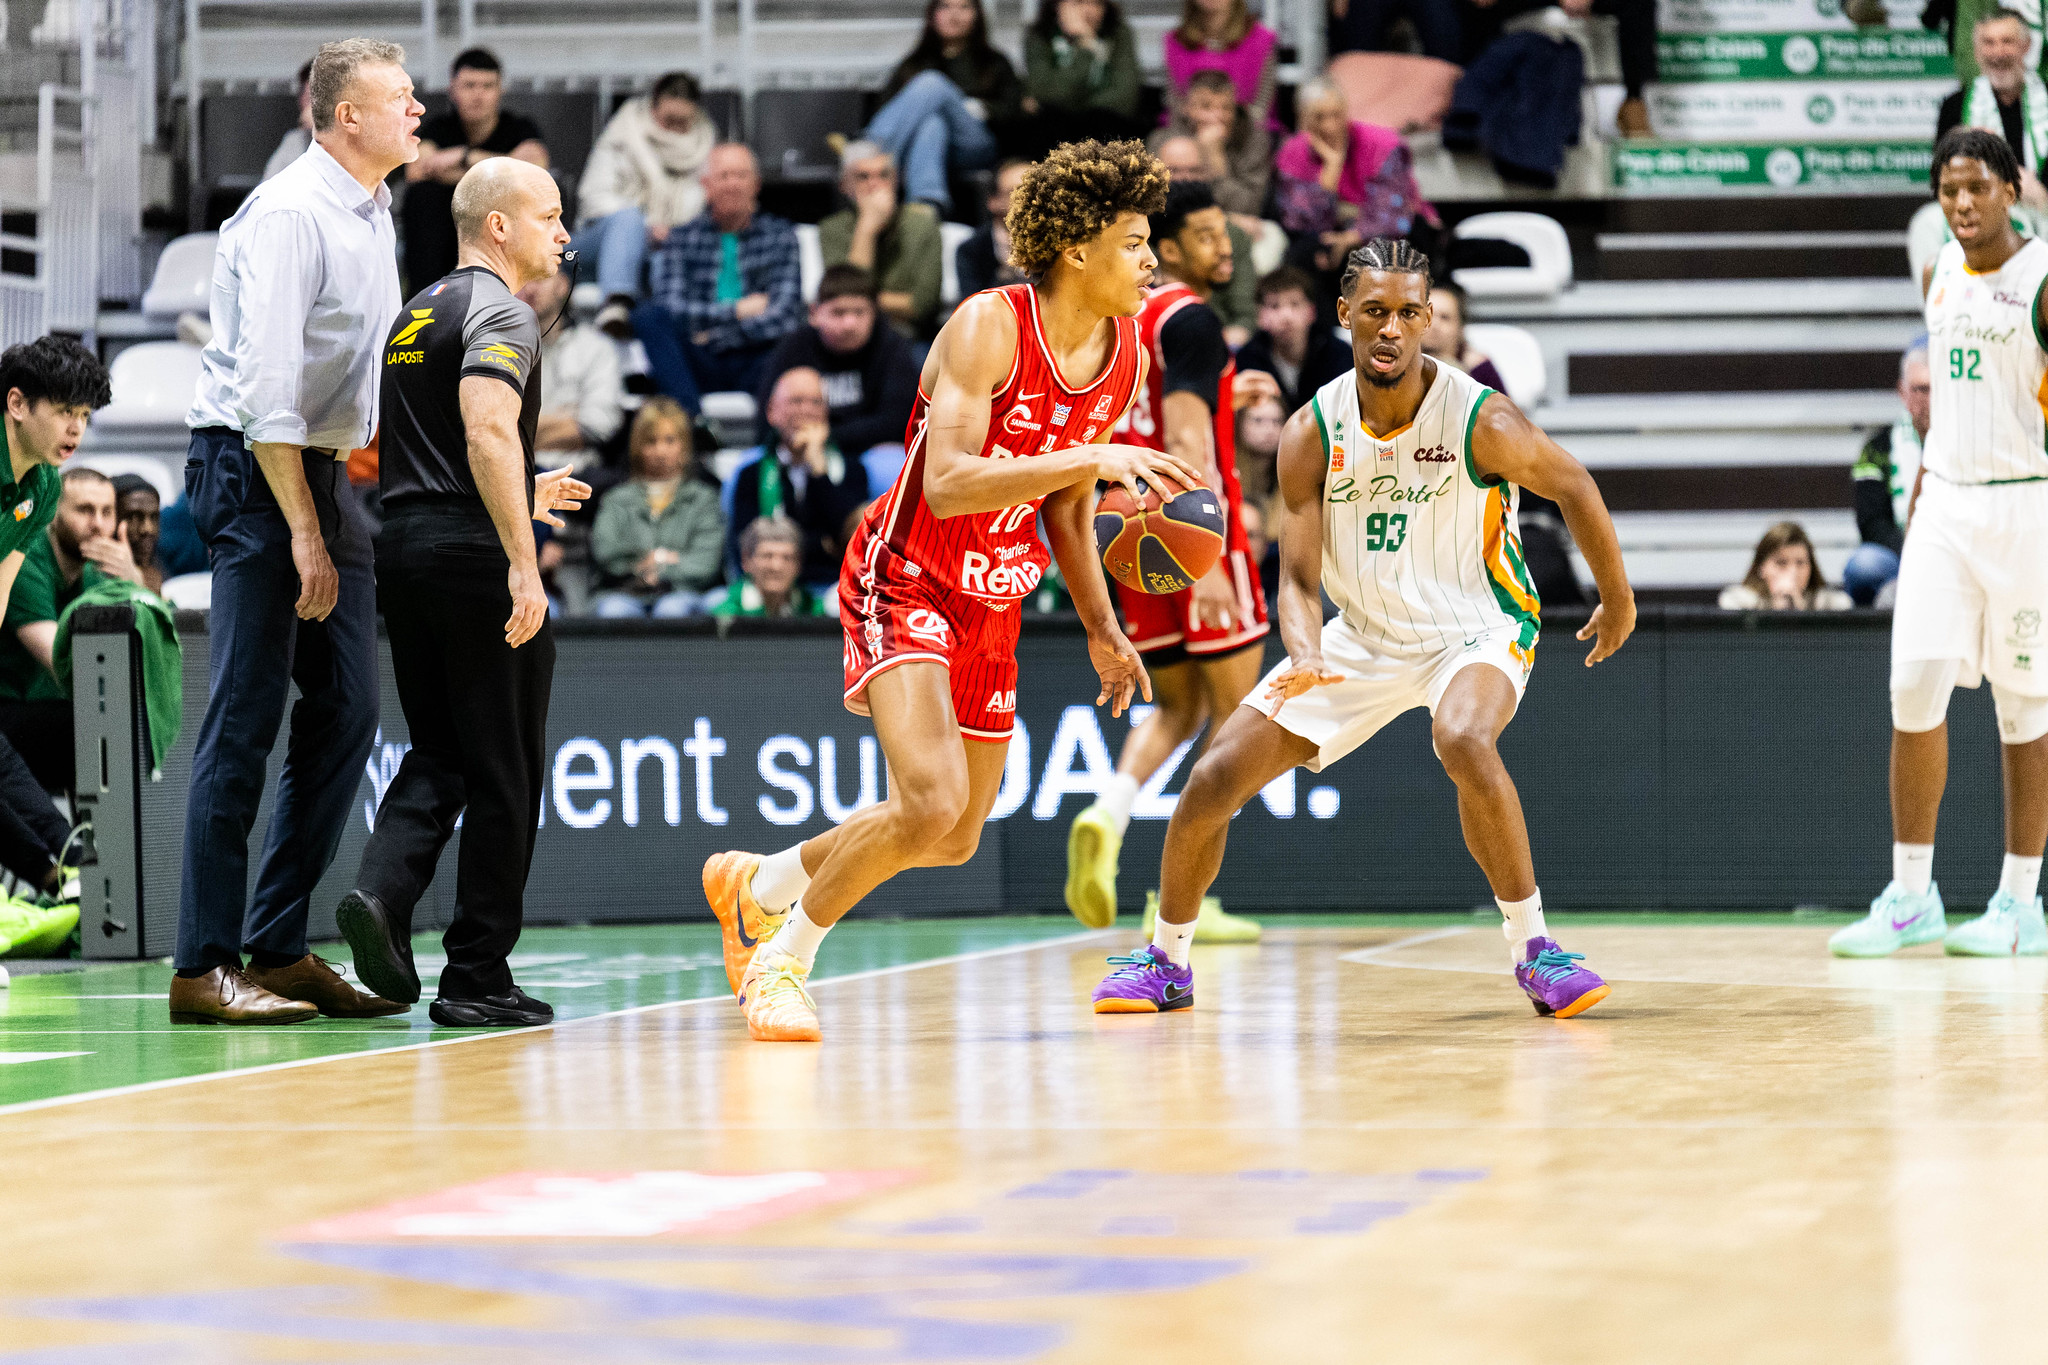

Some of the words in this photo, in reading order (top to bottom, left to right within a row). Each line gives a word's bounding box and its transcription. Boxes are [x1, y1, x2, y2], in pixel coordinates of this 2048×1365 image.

[387, 352, 398, 365] LA
[398, 351, 424, 364] POSTE
[480, 354, 495, 363] LA
[496, 356, 520, 377] POSTE
[1950, 347, 1983, 380] 92
[1010, 418, 1042, 431] SANNOVER
[1413, 447, 1456, 463] Chais
[1327, 477, 1362, 504] Le
[988, 503, 1035, 534] 10
[1366, 512, 1408, 552] 93
[994, 541, 1031, 561] Charles
[757, 734, 891, 826] su
